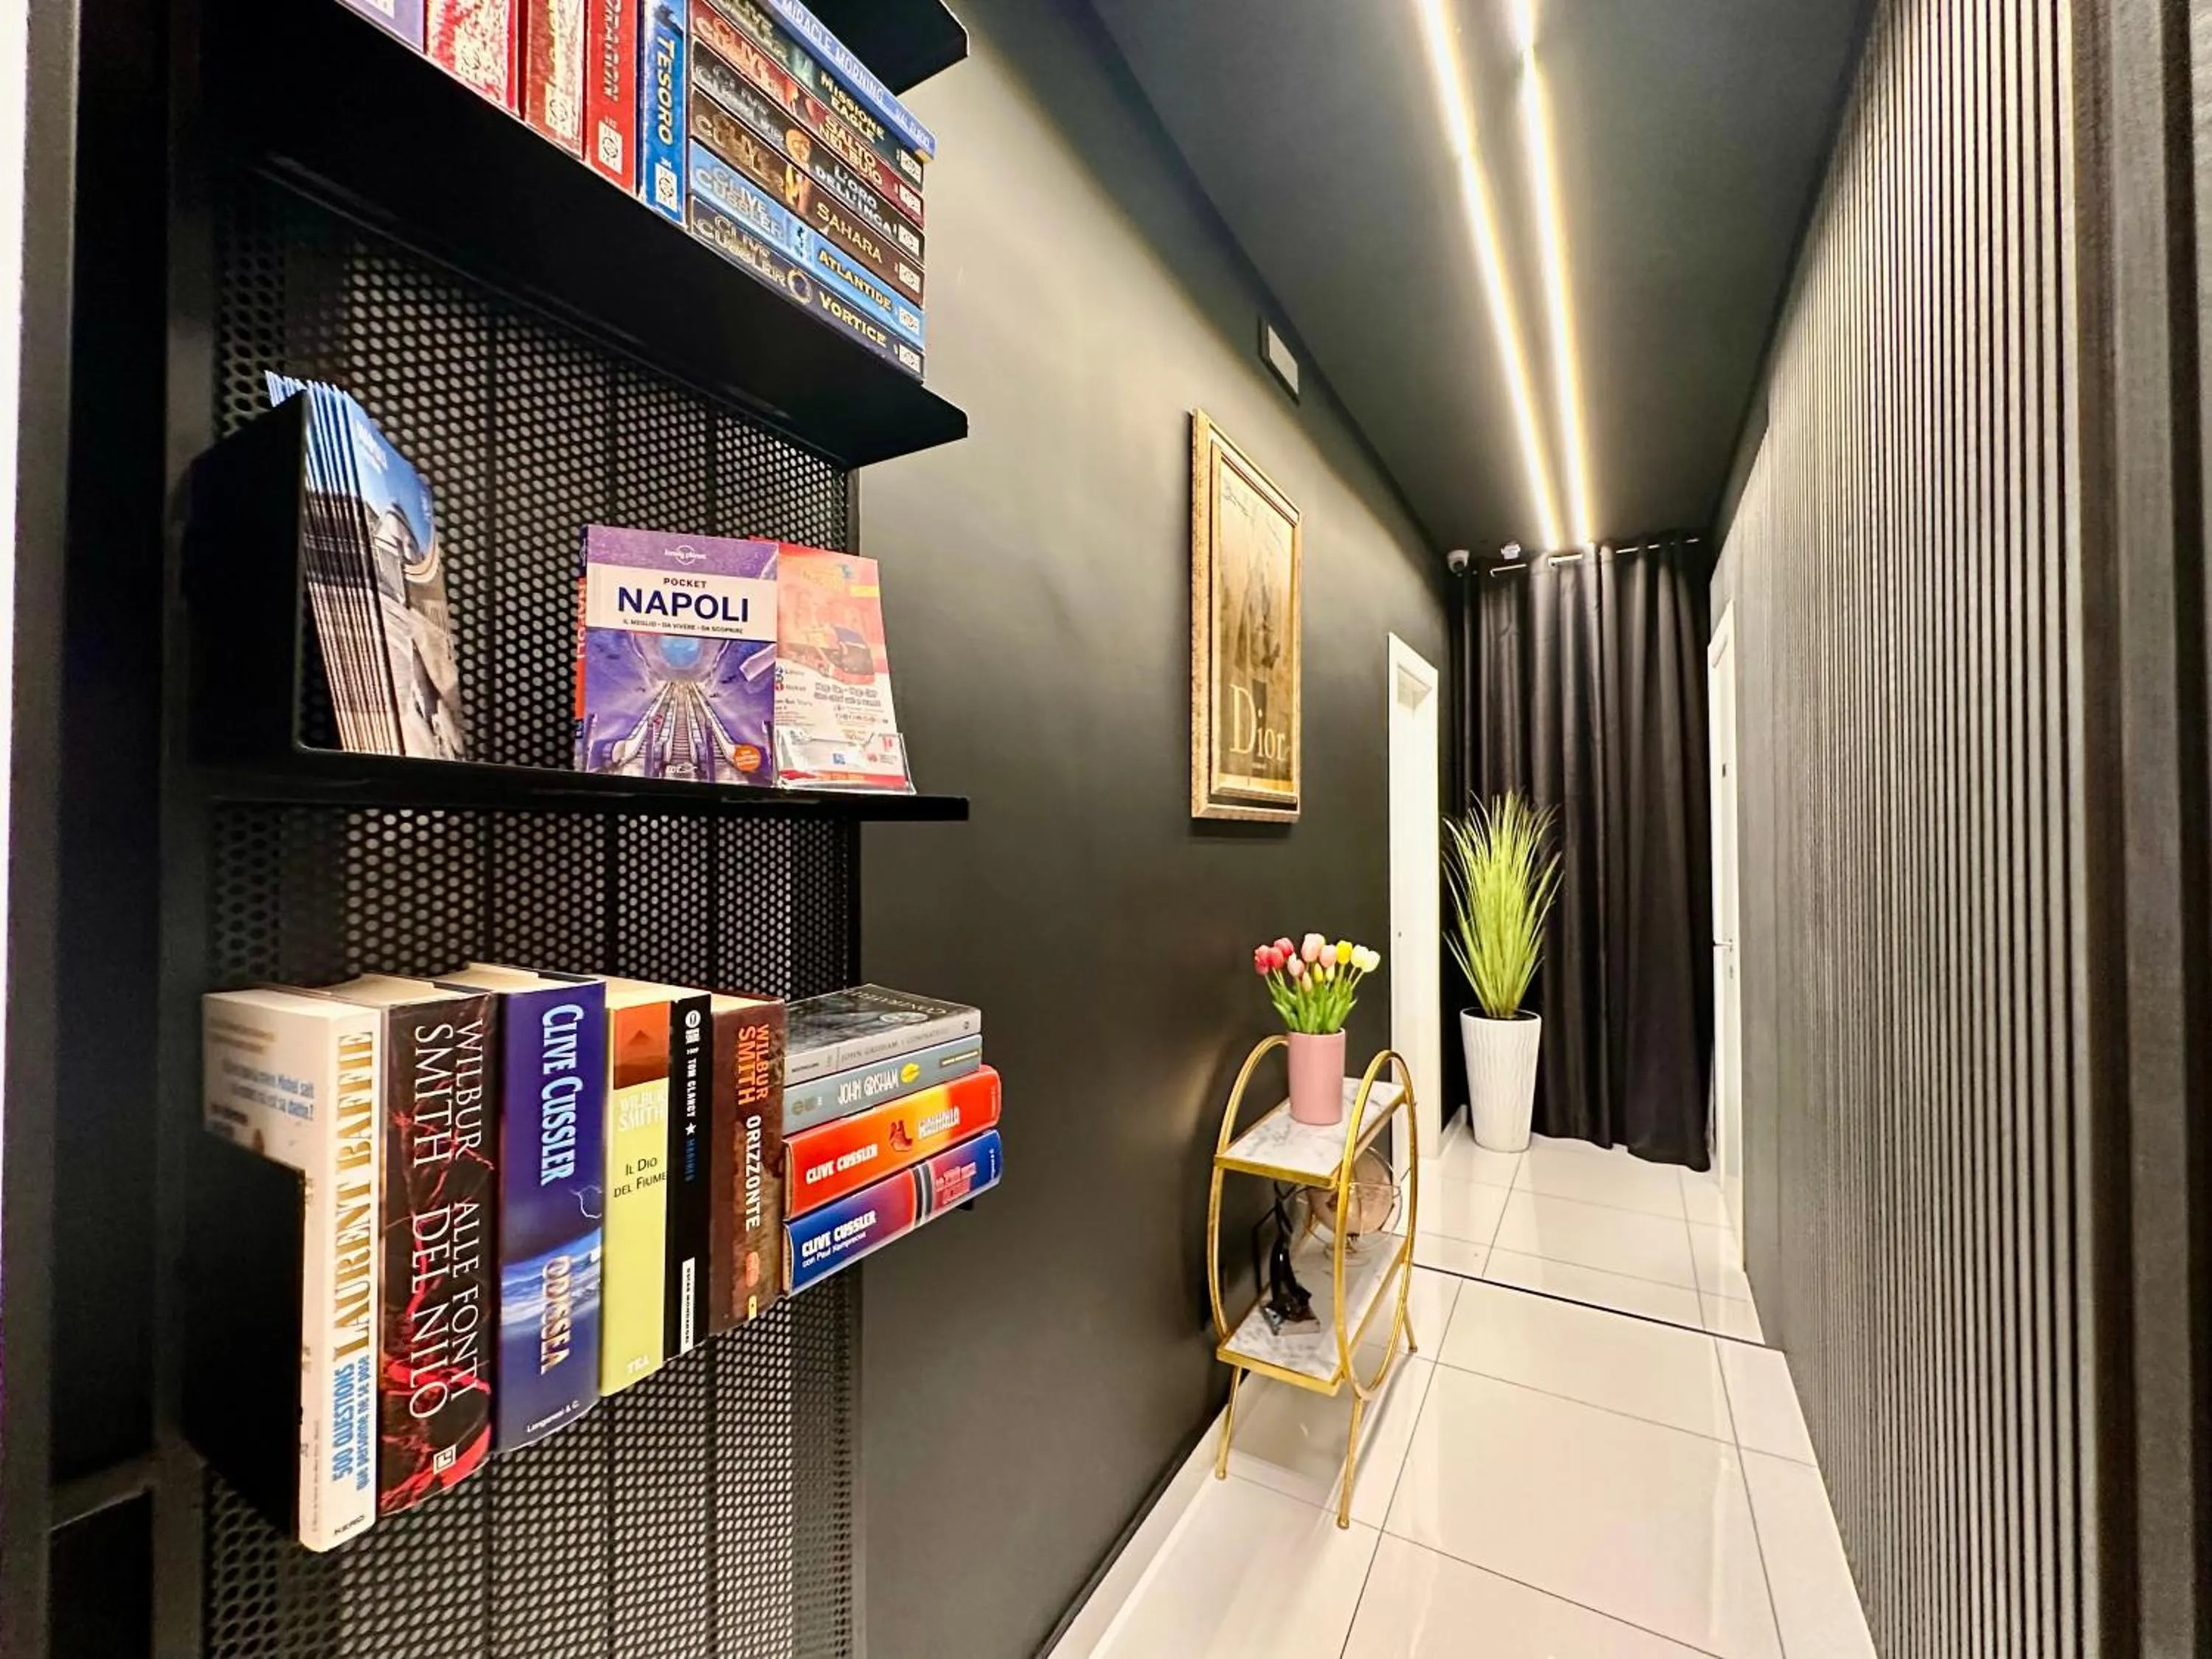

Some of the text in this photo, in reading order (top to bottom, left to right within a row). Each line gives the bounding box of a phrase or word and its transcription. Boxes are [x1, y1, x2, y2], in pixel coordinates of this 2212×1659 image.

[655, 38, 675, 147] TESORO
[835, 46, 884, 102] MORNING
[821, 70, 885, 140] MISSIONE
[831, 94, 875, 144] EAGLE
[819, 123, 883, 185] NEL BUIO
[824, 112, 876, 170] SALTO
[815, 164, 895, 236] DELL'INCA
[834, 164, 877, 207] L'ORO
[816, 202, 883, 263] SAHARA
[818, 248, 893, 311] ATLANTIDE
[819, 291, 887, 348] VORTICE
[617, 586, 748, 623] NAPOLI
[663, 577, 707, 588] POCKET
[1229, 684, 1286, 761] Dior
[455, 1018, 484, 1161] WILBUR
[686, 1057, 698, 1079] TOM
[738, 1026, 756, 1106] SMITH
[755, 1023, 770, 1101] WILBUR
[837, 1080, 862, 1105] JOHN
[414, 1023, 453, 1168] SMITH
[540, 1004, 585, 1187] CLIVE CUSSLER
[618, 1105, 665, 1133] SMITH
[686, 1079, 698, 1118] CLANCY
[636, 1169, 668, 1190] FIUME
[637, 1155, 658, 1172] DIO
[745, 1114, 762, 1232] ORIZZONTE
[805, 1144, 879, 1185] CLIVE CUSSLER
[334, 1032, 374, 1363] LAURENT BAFFIE
[801, 1211, 877, 1258] CLIVE CUSSLER
[816, 1249, 832, 1262] Paul
[409, 1204, 451, 1418] DEL NILO
[451, 1202, 479, 1401] ALLE FONTI
[540, 1255, 572, 1376] ODISSEA
[332, 1362, 355, 1483] 500 QUESTIONS
